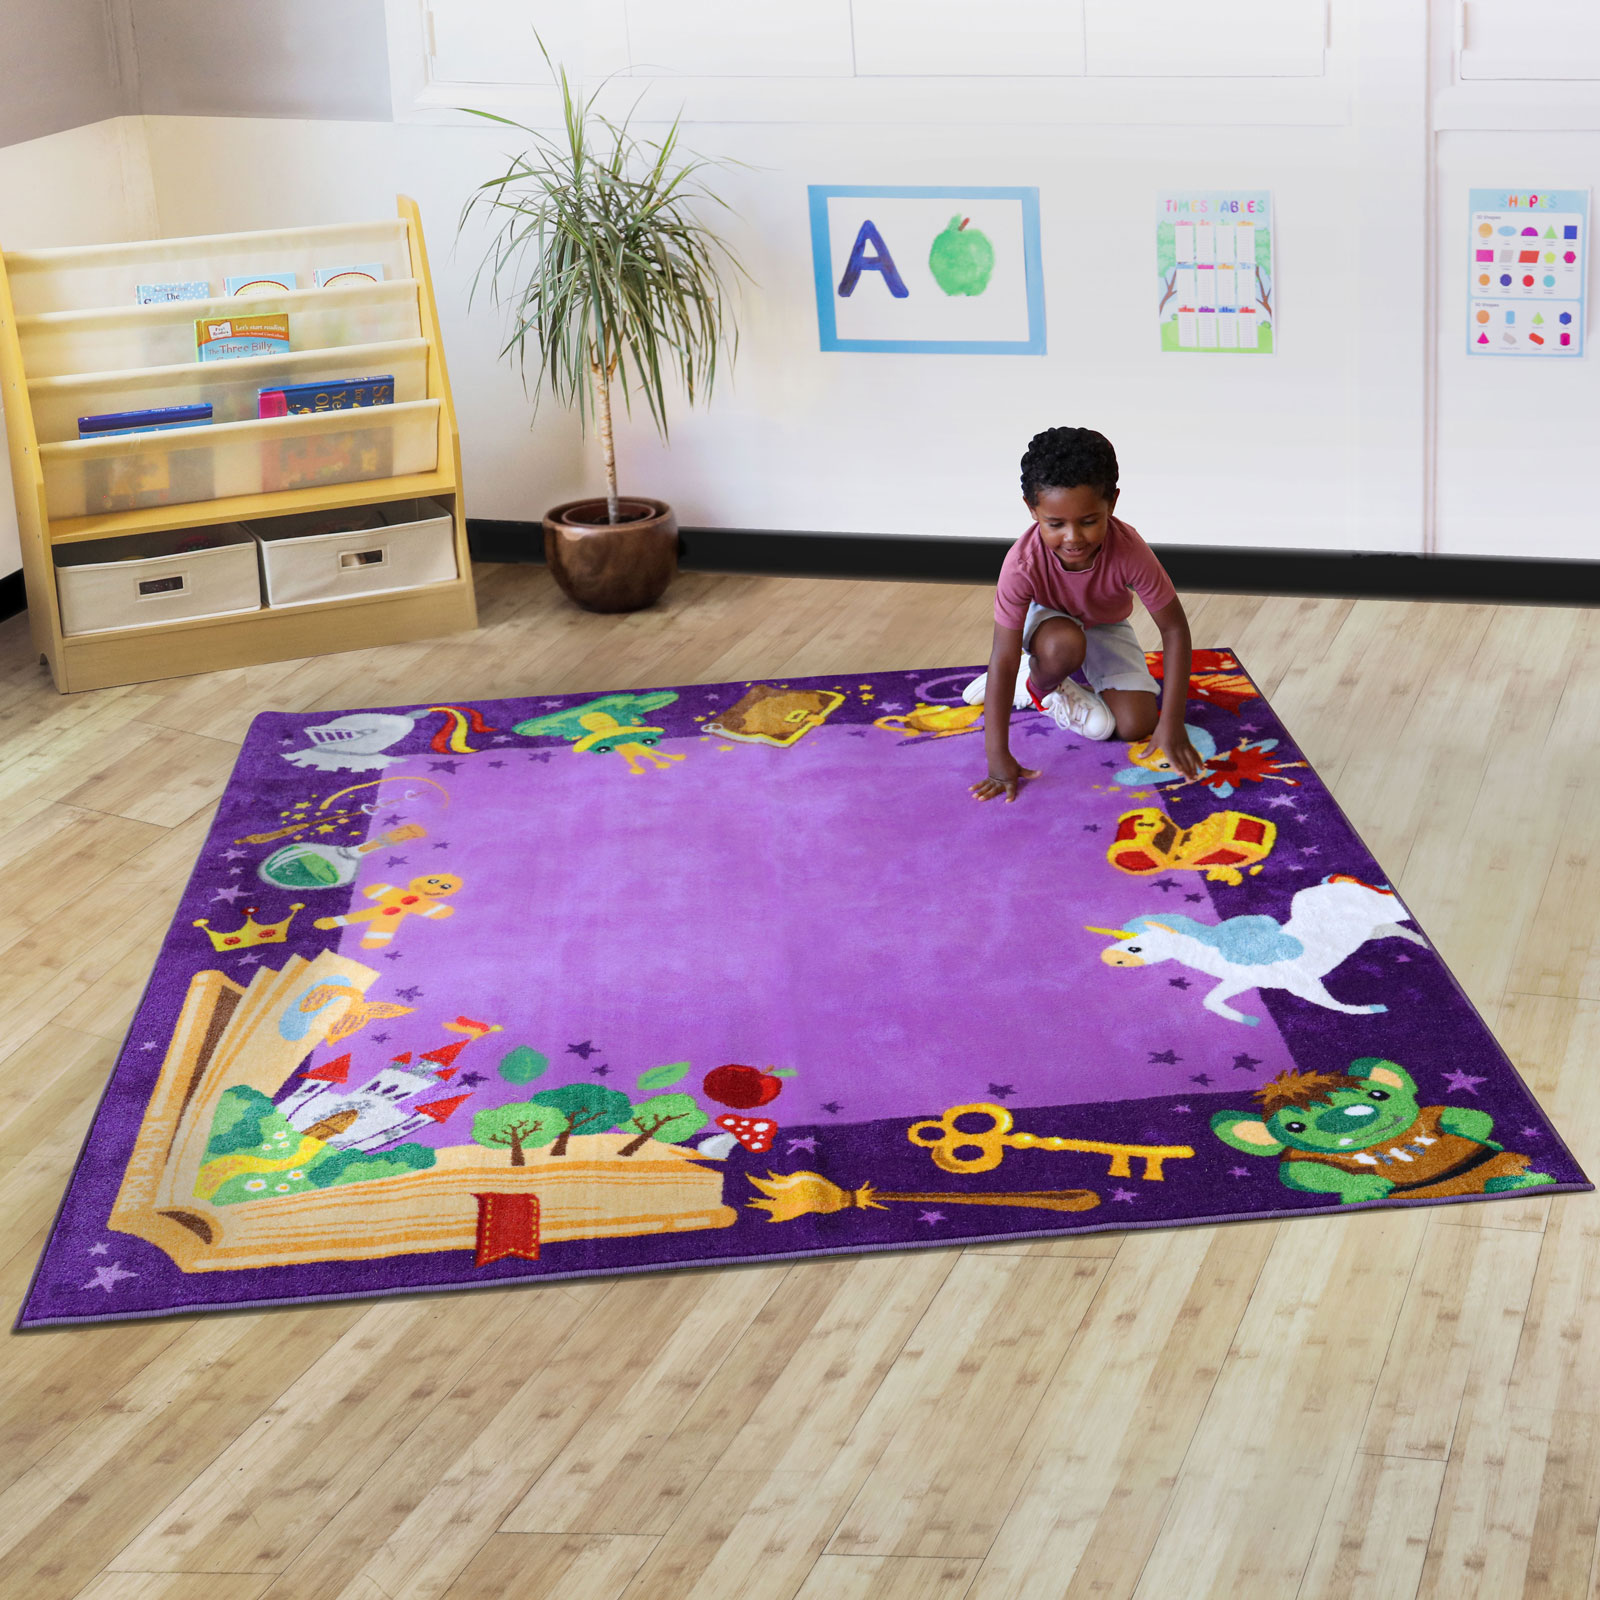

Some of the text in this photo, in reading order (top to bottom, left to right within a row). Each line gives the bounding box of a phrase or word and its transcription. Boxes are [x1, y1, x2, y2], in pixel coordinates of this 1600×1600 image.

[1166, 200, 1265, 213] TIMES TABLES
[1499, 194, 1558, 208] SHAPES
[838, 219, 909, 298] A
[166, 293, 180, 301] The
[263, 324, 286, 332] reading
[219, 343, 249, 354] Three
[251, 341, 272, 351] Billy
[118, 1121, 170, 1213] Kit for Kids
